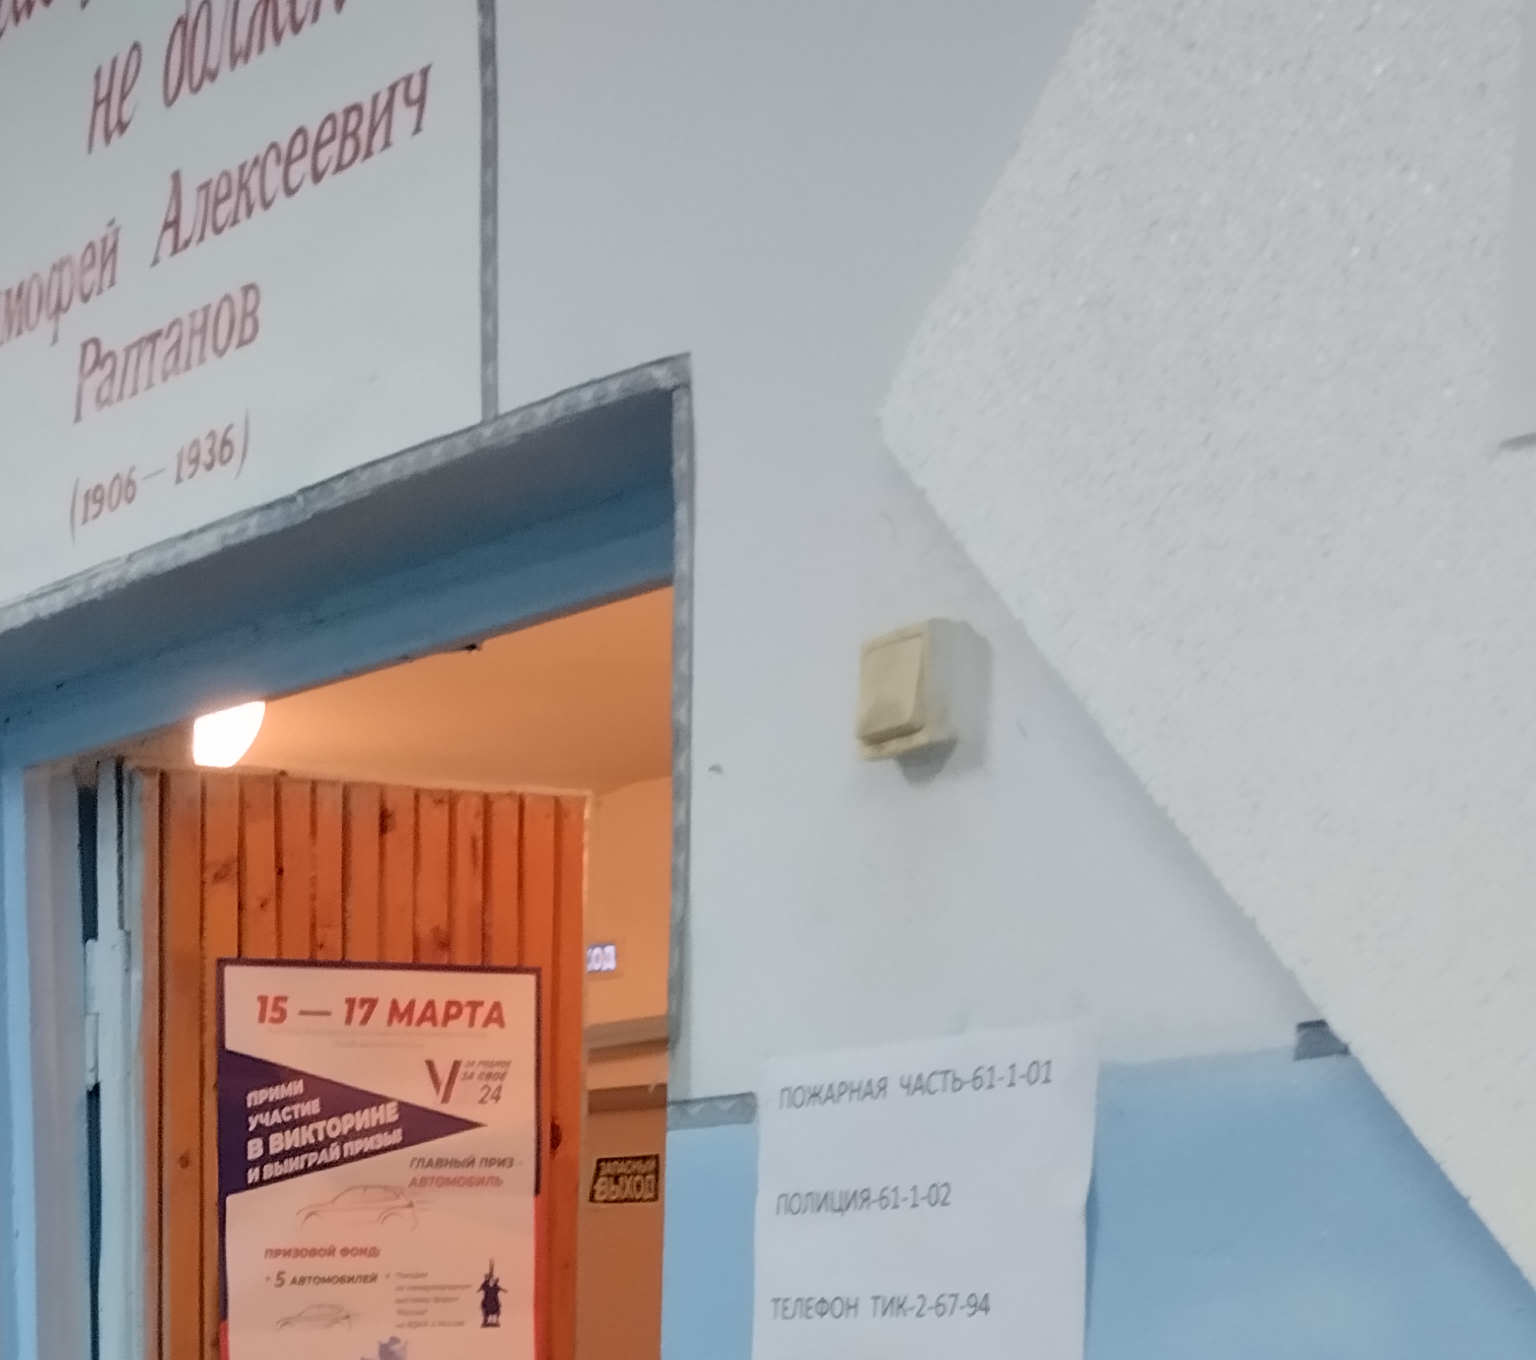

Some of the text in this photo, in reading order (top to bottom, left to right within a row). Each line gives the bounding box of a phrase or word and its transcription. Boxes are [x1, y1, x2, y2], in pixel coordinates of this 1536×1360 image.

[86, 40, 143, 155] не
[150, 63, 432, 268] Алексеевич
[73, 282, 261, 424] Раптанов
[257, 995, 288, 1025] 15
[344, 997, 379, 1027] 17
[386, 998, 506, 1029] МАРТА
[246, 1079, 304, 1109] ПРИМИ
[478, 1083, 504, 1105] 24
[779, 1059, 1053, 1110] ПОЖАРНАЯ ЧАСТЬ-61-1-01
[247, 1101, 400, 1162] В ВИКТОРИНЕ
[248, 1097, 321, 1132] УЧАСТИЕ
[247, 1165, 261, 1184] И
[262, 1141, 342, 1181] ВЫИГРАЙ
[408, 1153, 477, 1170] ГЛАВНЫЙ
[478, 1156, 516, 1170] ПРИЗ
[407, 1174, 504, 1189] АВТОМОБИЛЬ
[593, 1173, 655, 1200] ВЫХОД
[775, 1181, 953, 1217] ПОЛИЦИЯ-61-1-02
[264, 1244, 337, 1260] ПРИЗОВОЙ
[274, 1269, 287, 1289] 5
[288, 1271, 379, 1287] АВТОМОБИЛЕЙ
[770, 1292, 991, 1321] ТЕЛЕФОН ТИК-2-67-94
